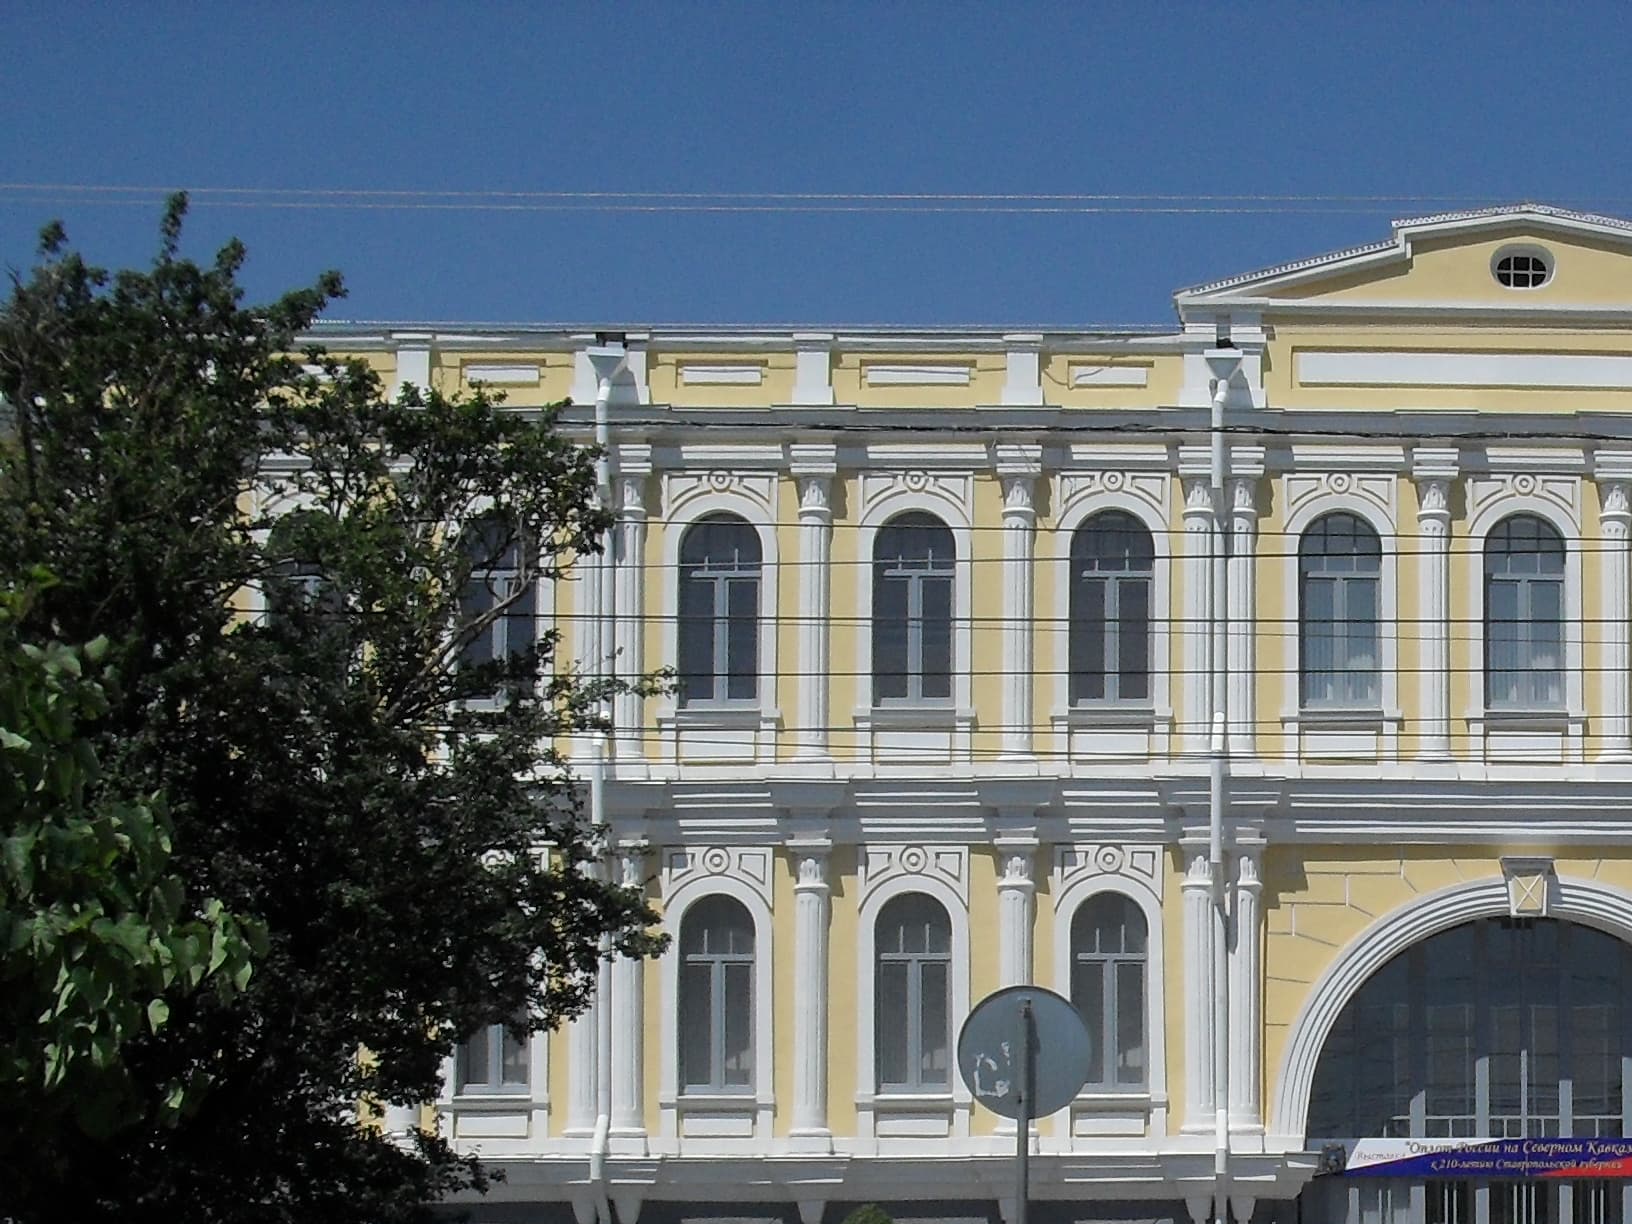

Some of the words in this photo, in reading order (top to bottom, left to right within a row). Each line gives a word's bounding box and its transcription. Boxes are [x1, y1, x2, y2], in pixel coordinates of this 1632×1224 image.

[1455, 1141, 1499, 1154] России
[1503, 1143, 1519, 1153] на
[1523, 1140, 1582, 1156] Северном
